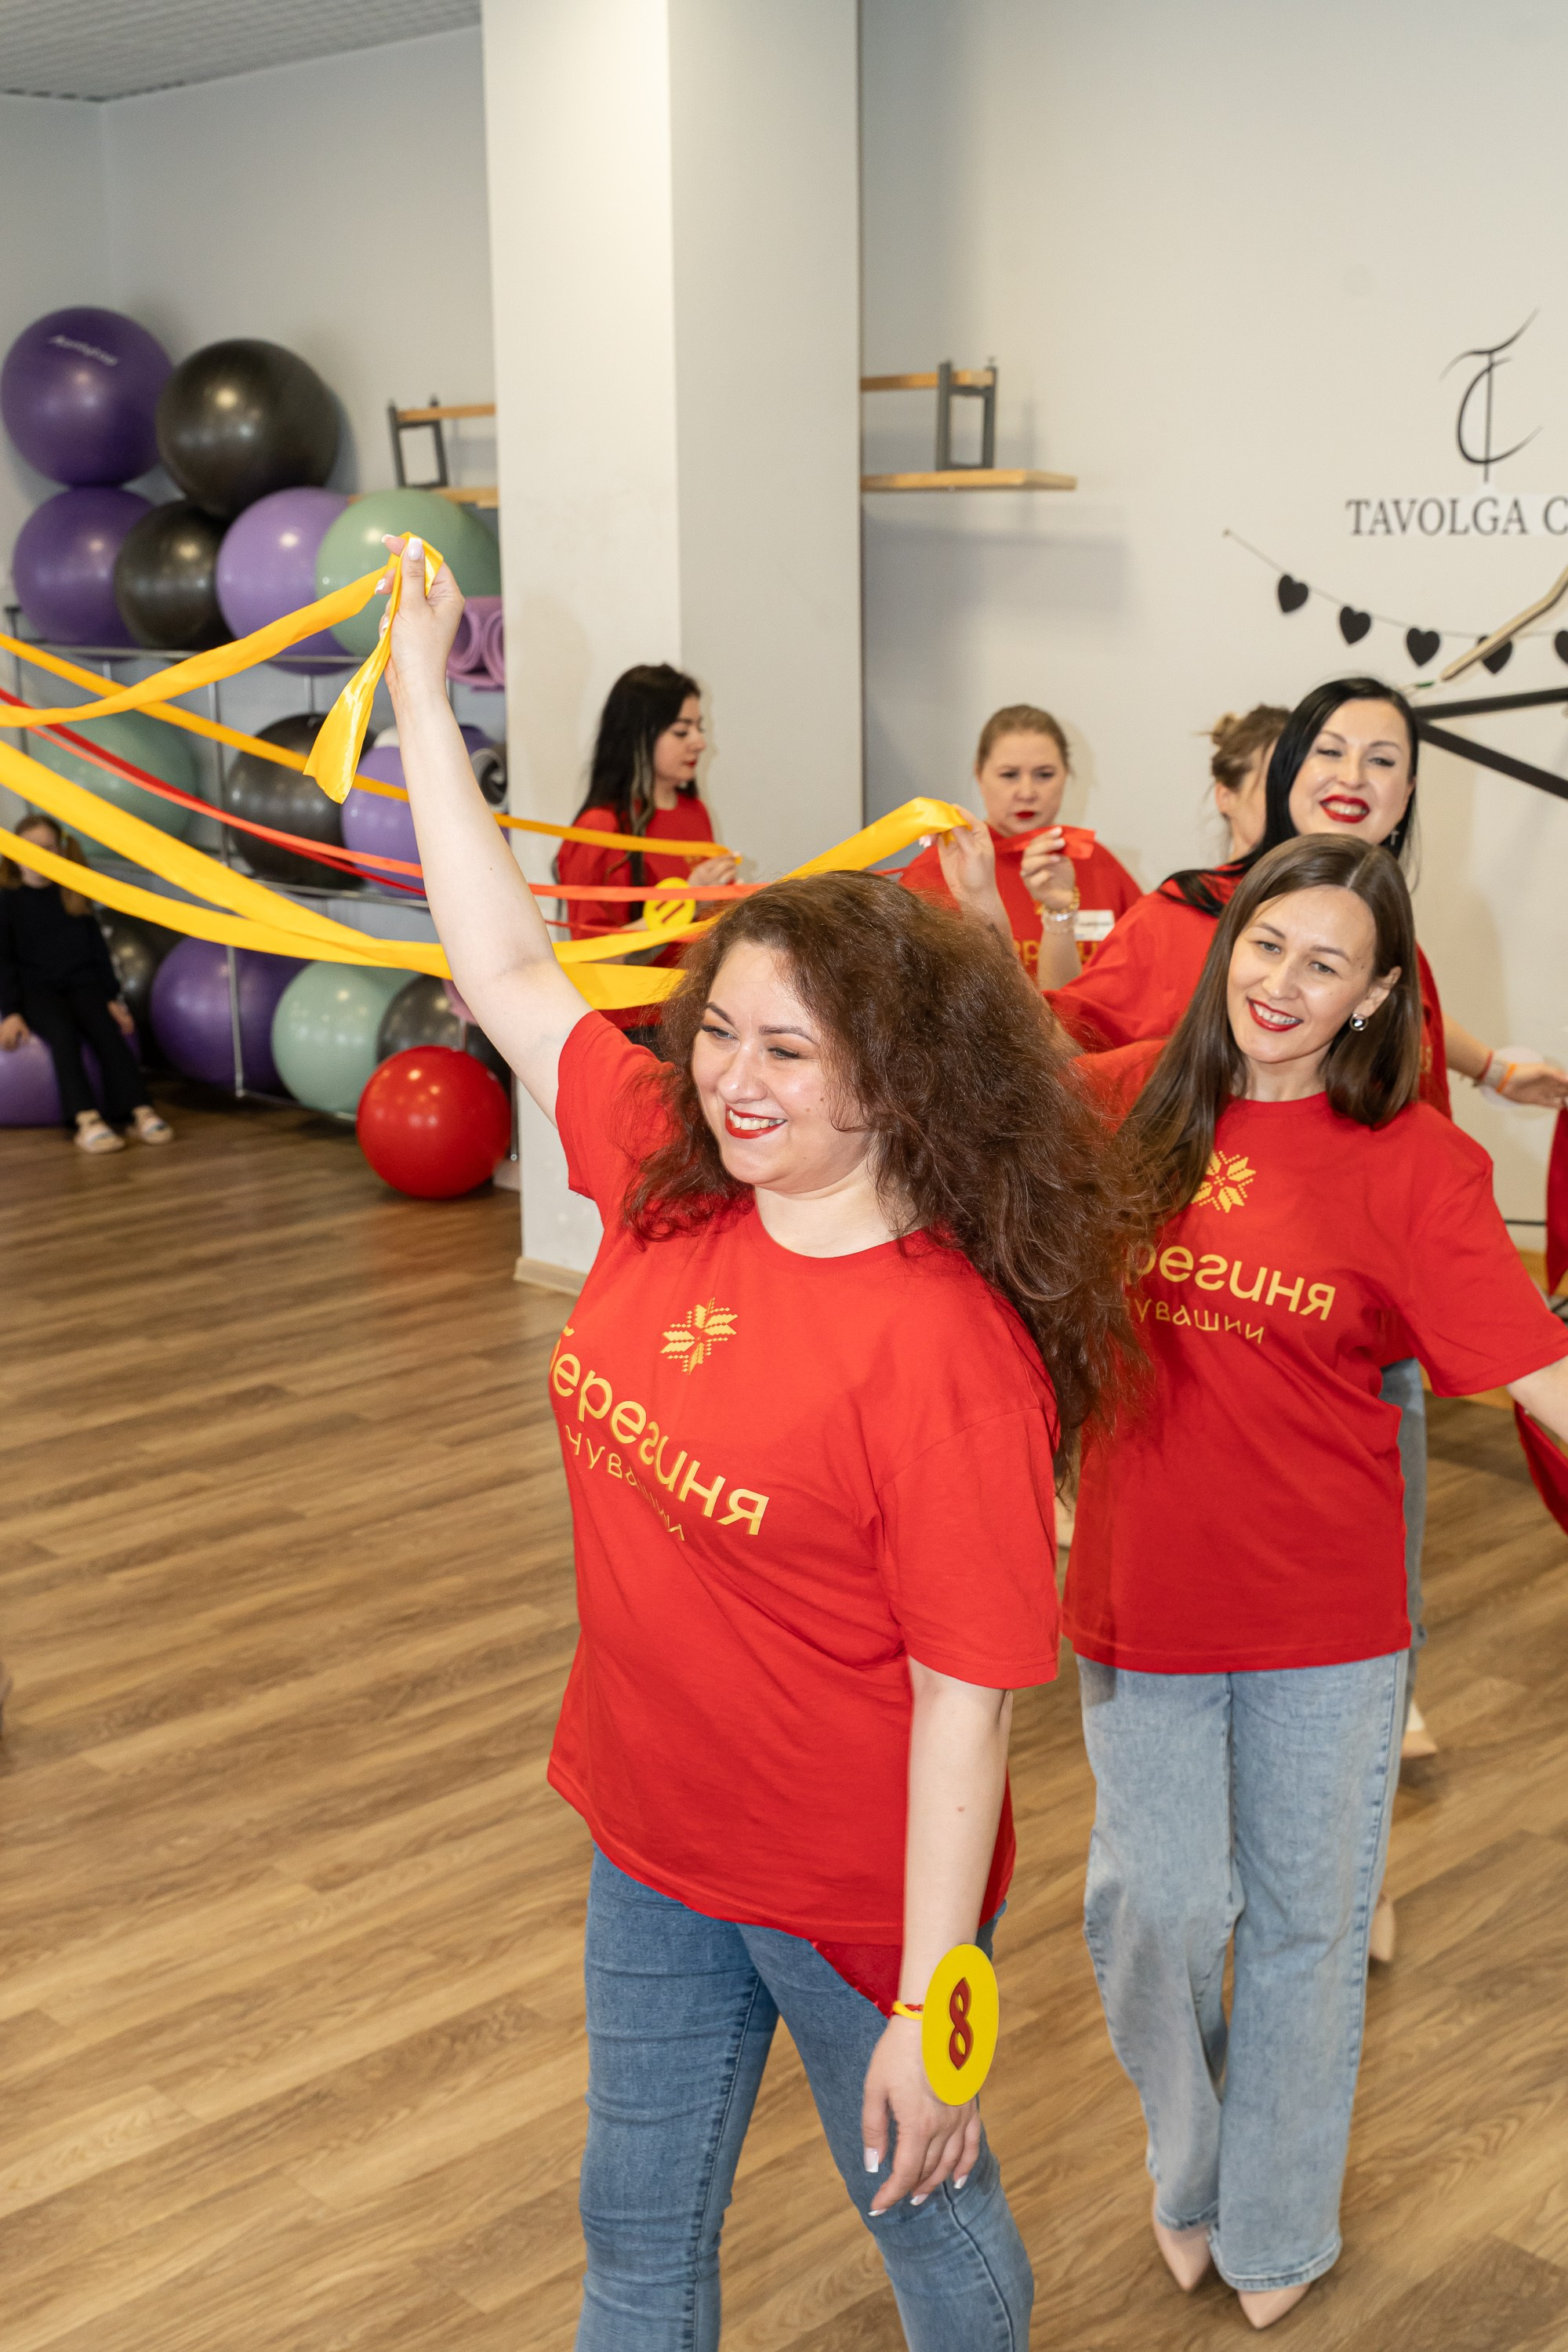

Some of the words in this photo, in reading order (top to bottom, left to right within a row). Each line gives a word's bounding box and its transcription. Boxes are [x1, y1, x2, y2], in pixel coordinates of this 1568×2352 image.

[1345, 497, 1528, 535] TAVOLGA
[1125, 1244, 1336, 1321] региня
[1134, 1298, 1265, 1345] увашии
[550, 1327, 770, 1536] ерегиня
[949, 1976, 975, 2071] 8
